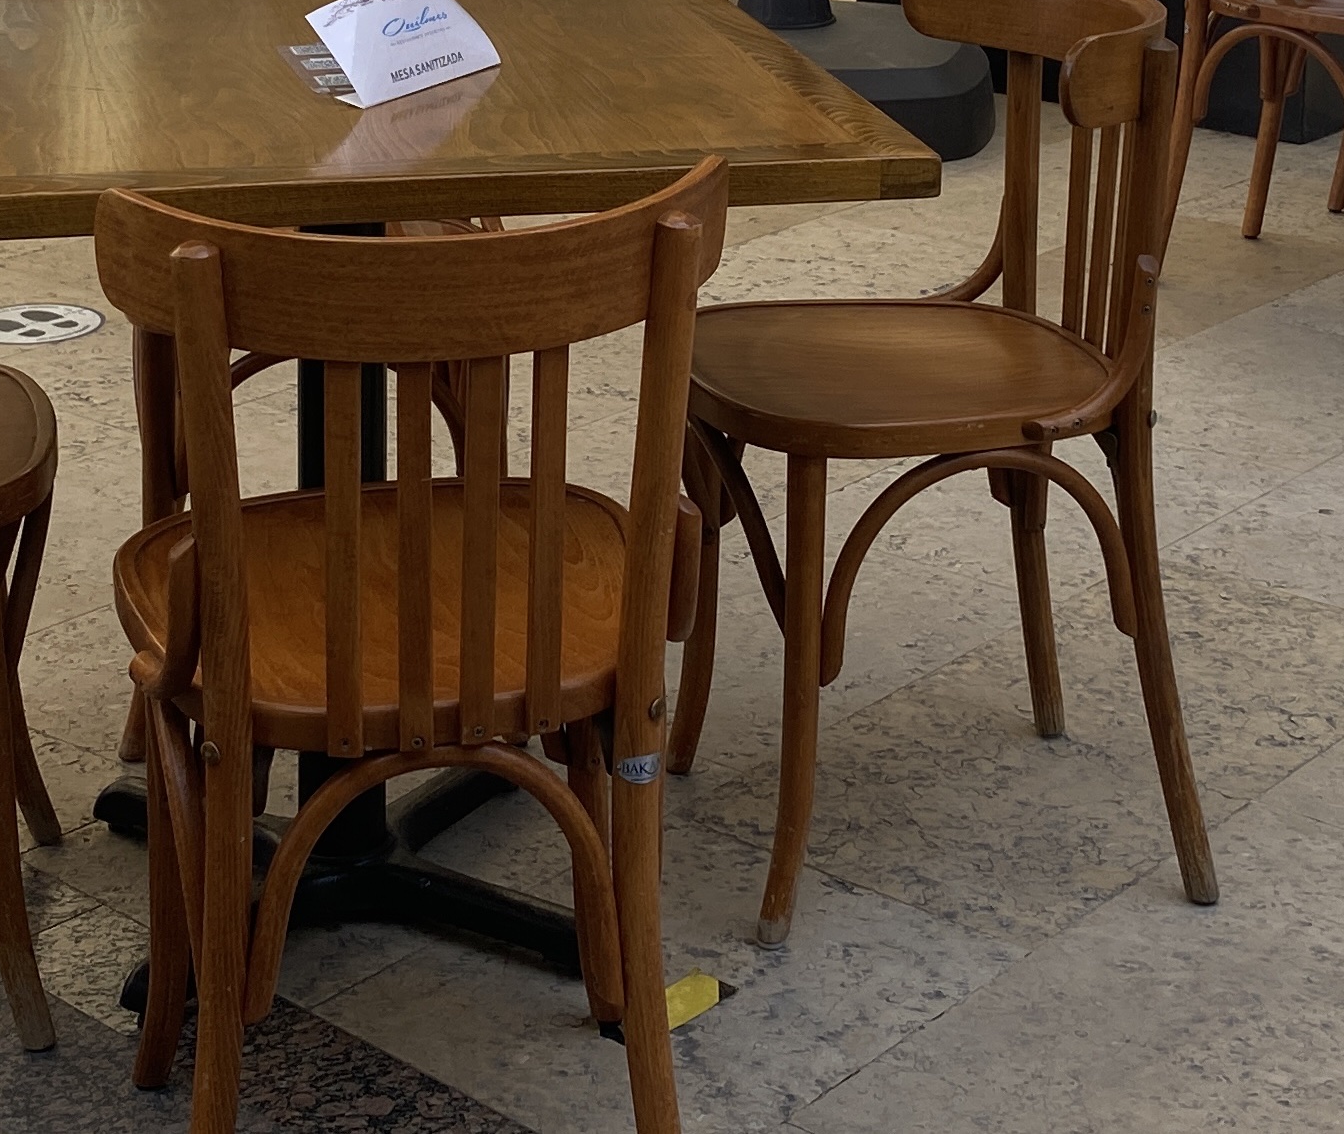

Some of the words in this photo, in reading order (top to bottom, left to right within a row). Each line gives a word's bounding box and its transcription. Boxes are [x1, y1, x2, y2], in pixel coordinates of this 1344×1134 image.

[382, 6, 448, 38] Quilmes
[390, 66, 416, 84] MESA
[414, 51, 465, 77] SANITIZADA
